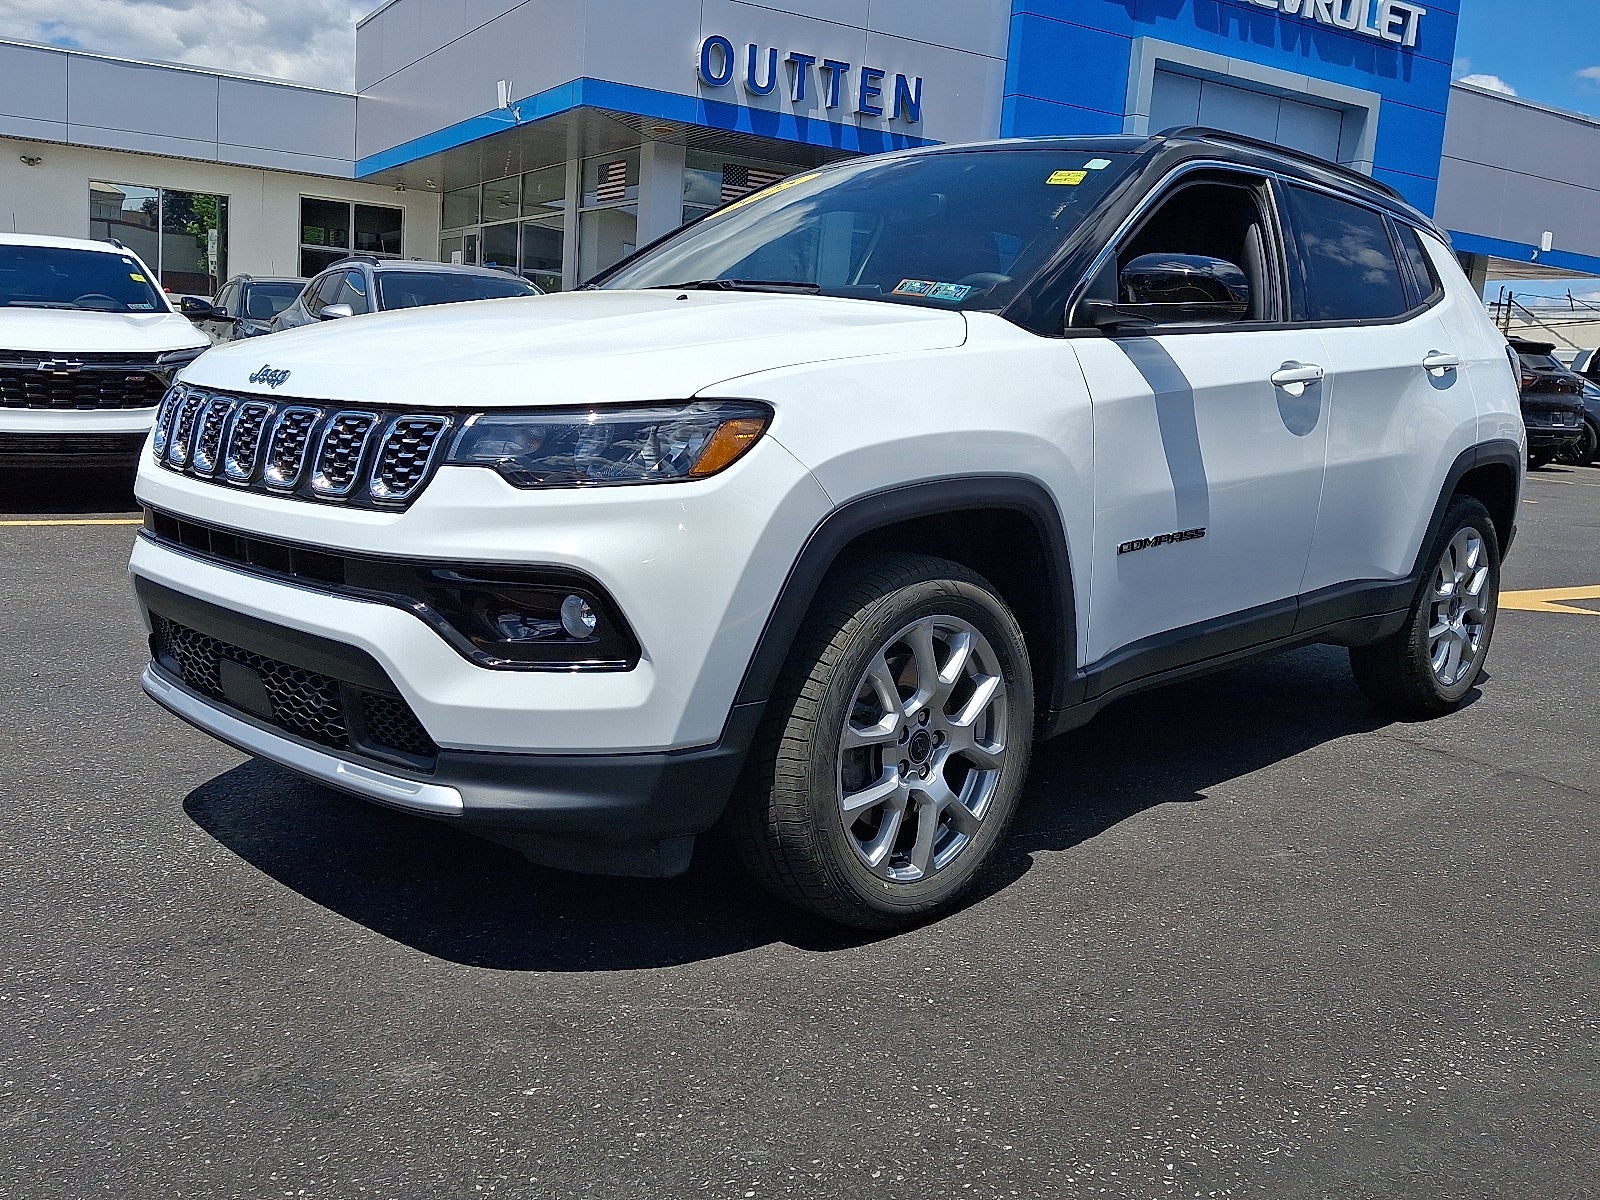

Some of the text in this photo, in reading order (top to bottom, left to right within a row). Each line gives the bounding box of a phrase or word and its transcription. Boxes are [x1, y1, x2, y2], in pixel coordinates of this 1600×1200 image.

[1247, 0, 1427, 47] ROLET
[697, 35, 923, 123] OUTTEN
[249, 364, 291, 389] Jeep
[1116, 527, 1207, 556] COMPASS
